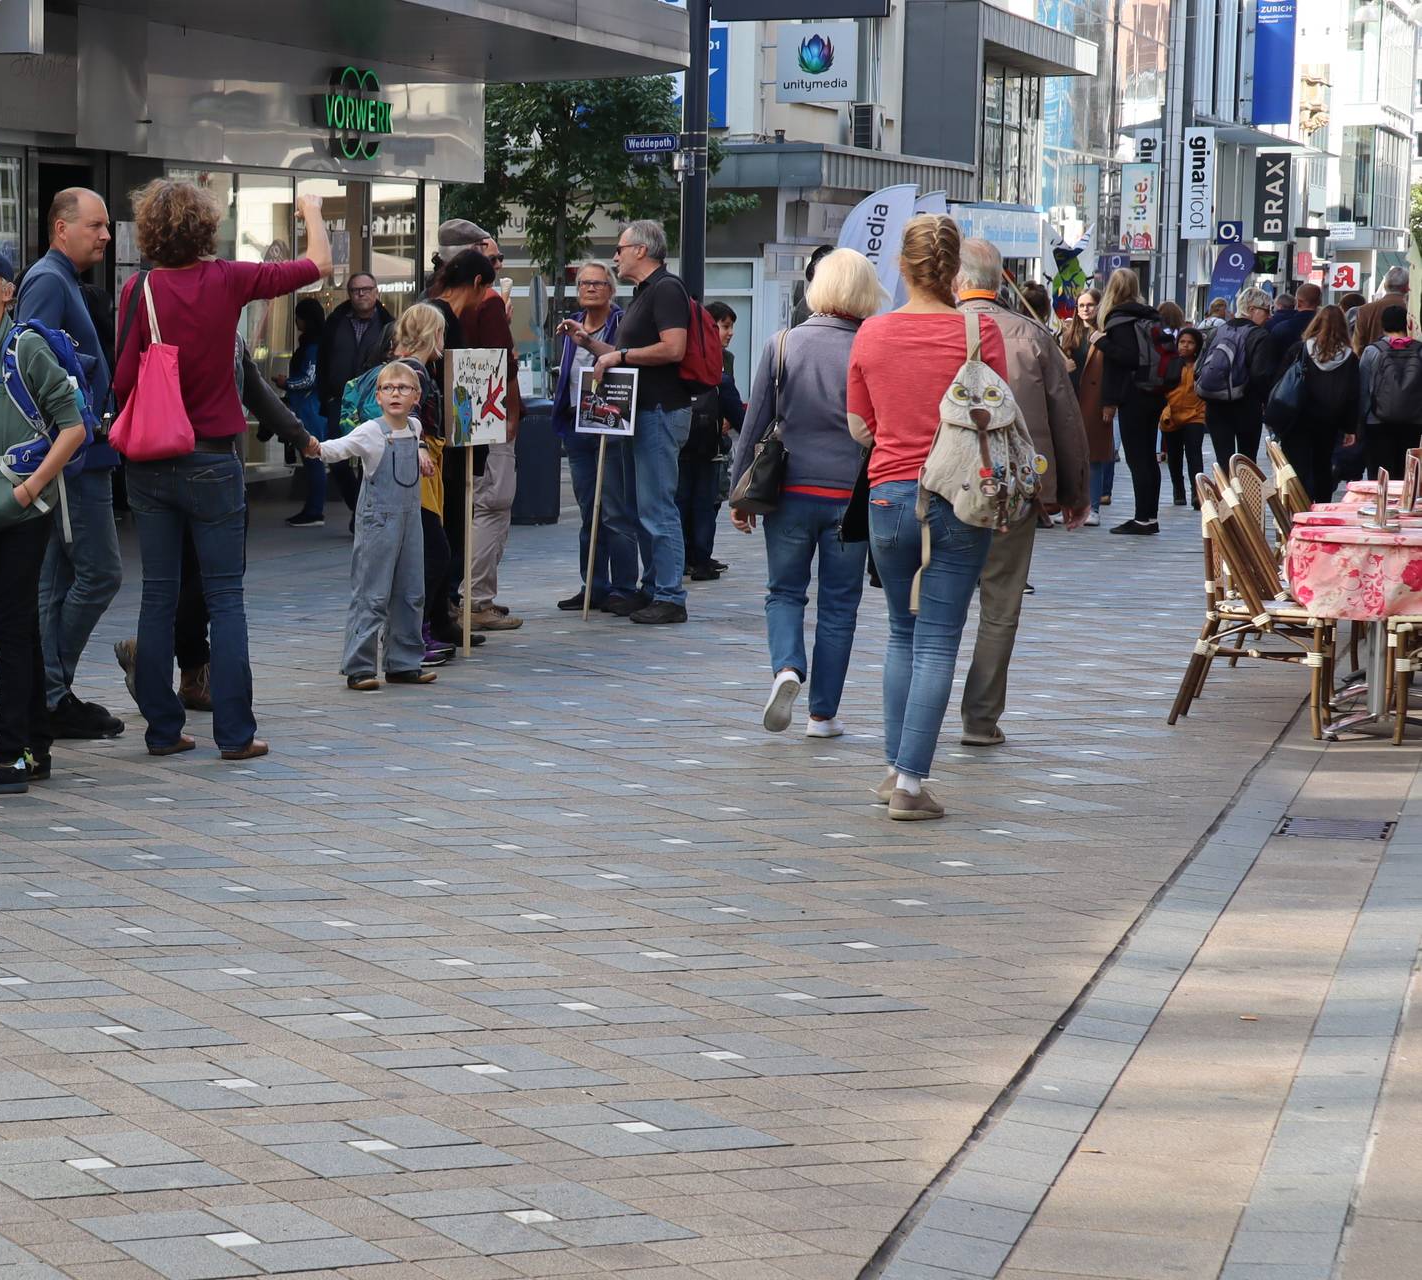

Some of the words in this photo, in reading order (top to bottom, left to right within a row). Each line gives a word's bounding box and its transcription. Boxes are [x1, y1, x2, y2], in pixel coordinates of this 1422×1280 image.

[1260, 5, 1292, 13] ZURICH
[783, 78, 848, 92] unitymedia
[325, 94, 394, 134] VORWERK
[628, 138, 672, 149] Weddepoth
[1189, 136, 1210, 230] ginatricot
[1263, 160, 1285, 234] BRAX
